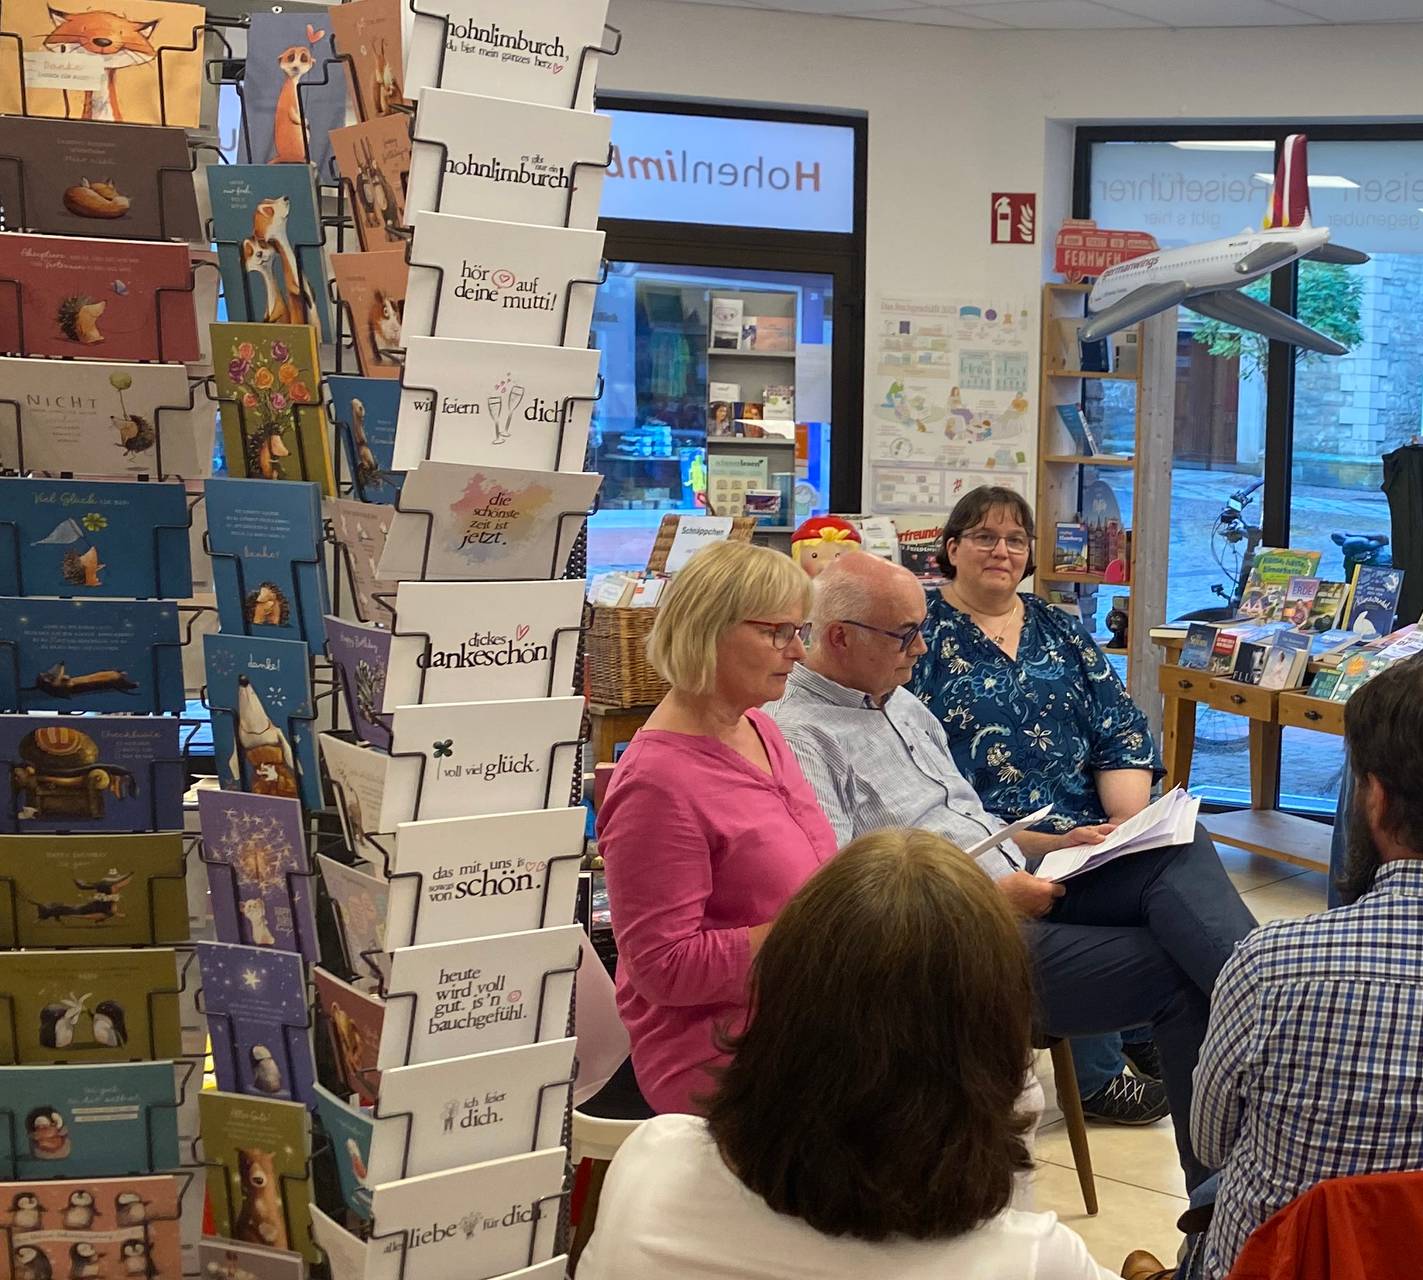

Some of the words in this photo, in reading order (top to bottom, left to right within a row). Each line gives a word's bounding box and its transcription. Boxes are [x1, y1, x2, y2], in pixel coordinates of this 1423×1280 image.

[479, 47, 498, 58] mein
[502, 52, 530, 65] ganzes
[534, 56, 553, 70] herz
[461, 260, 490, 281] hör
[516, 277, 540, 294] auf
[1102, 255, 1161, 281] germanwings
[455, 280, 499, 303] deine
[501, 292, 557, 312] mutti!
[26, 393, 98, 409] NICHT
[442, 397, 480, 415] feiern
[489, 492, 512, 506] die
[473, 505, 521, 519] schönste
[470, 519, 490, 531] zeit
[494, 519, 509, 530] ist
[457, 530, 507, 550] jetzt.
[468, 631, 507, 648] dickes
[444, 765, 462, 778] voll
[466, 763, 483, 776] viel
[484, 753, 540, 781] glück.
[433, 865, 454, 880] das
[459, 861, 481, 877] mit
[489, 858, 512, 871] uns
[516, 857, 526, 868] is
[428, 891, 452, 902] von
[455, 869, 542, 900] schön.
[438, 967, 482, 985] heute
[436, 981, 471, 1001] wird
[477, 976, 505, 994] voll
[428, 1004, 528, 1035] bauchgefühl.
[434, 1001, 466, 1020] gut.
[464, 1096, 480, 1109] ich
[460, 1110, 503, 1129] dich.
[407, 1222, 458, 1250] liebe
[482, 1217, 501, 1232] für
